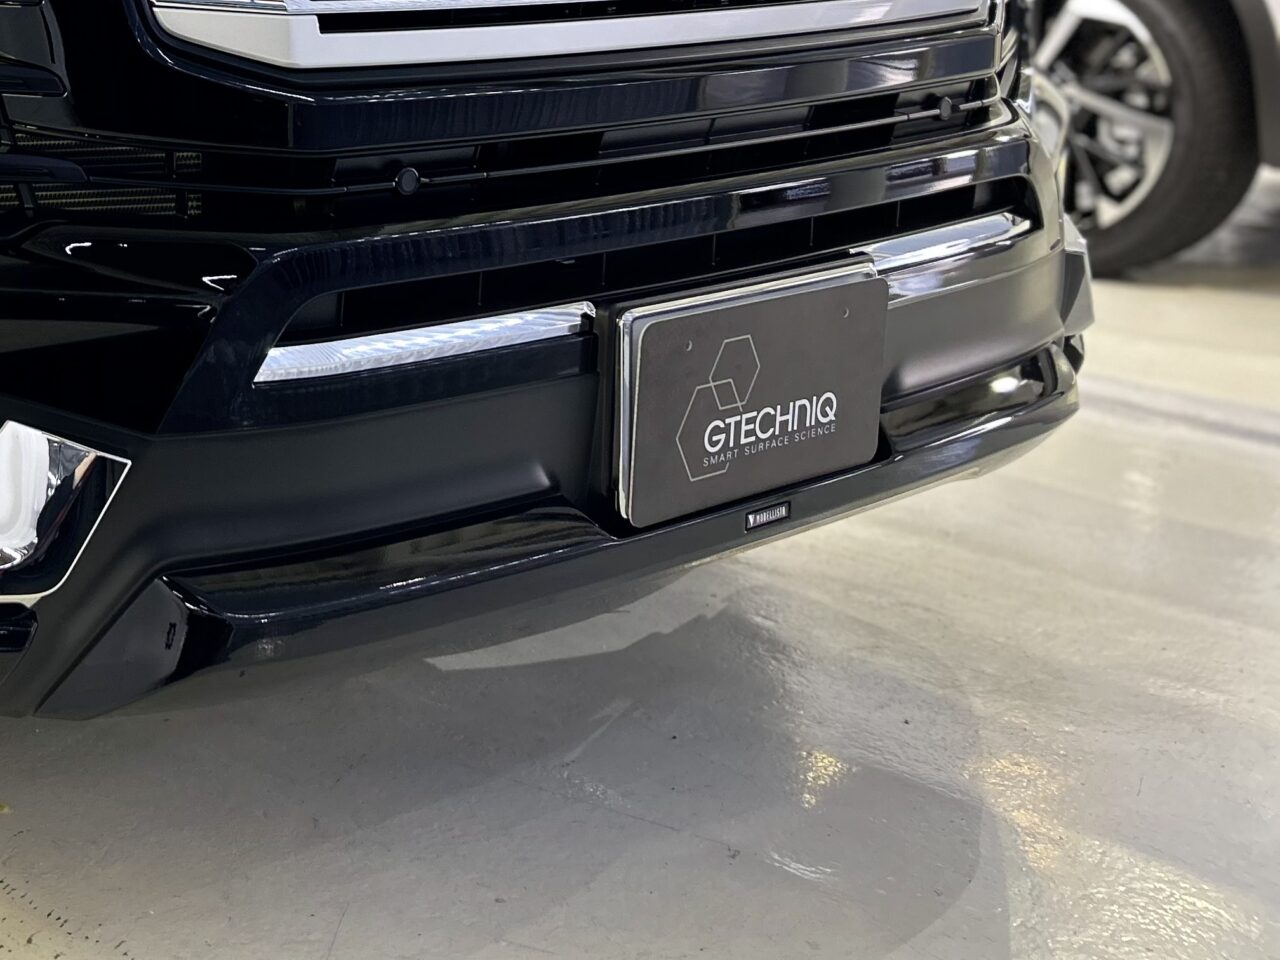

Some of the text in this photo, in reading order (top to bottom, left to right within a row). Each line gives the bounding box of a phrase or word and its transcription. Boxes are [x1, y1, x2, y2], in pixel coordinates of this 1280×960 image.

[704, 392, 837, 453] GTECHNIQ
[703, 423, 837, 467] SMART SURFACE SCIENCE
[756, 505, 786, 525] MODELLISTA
